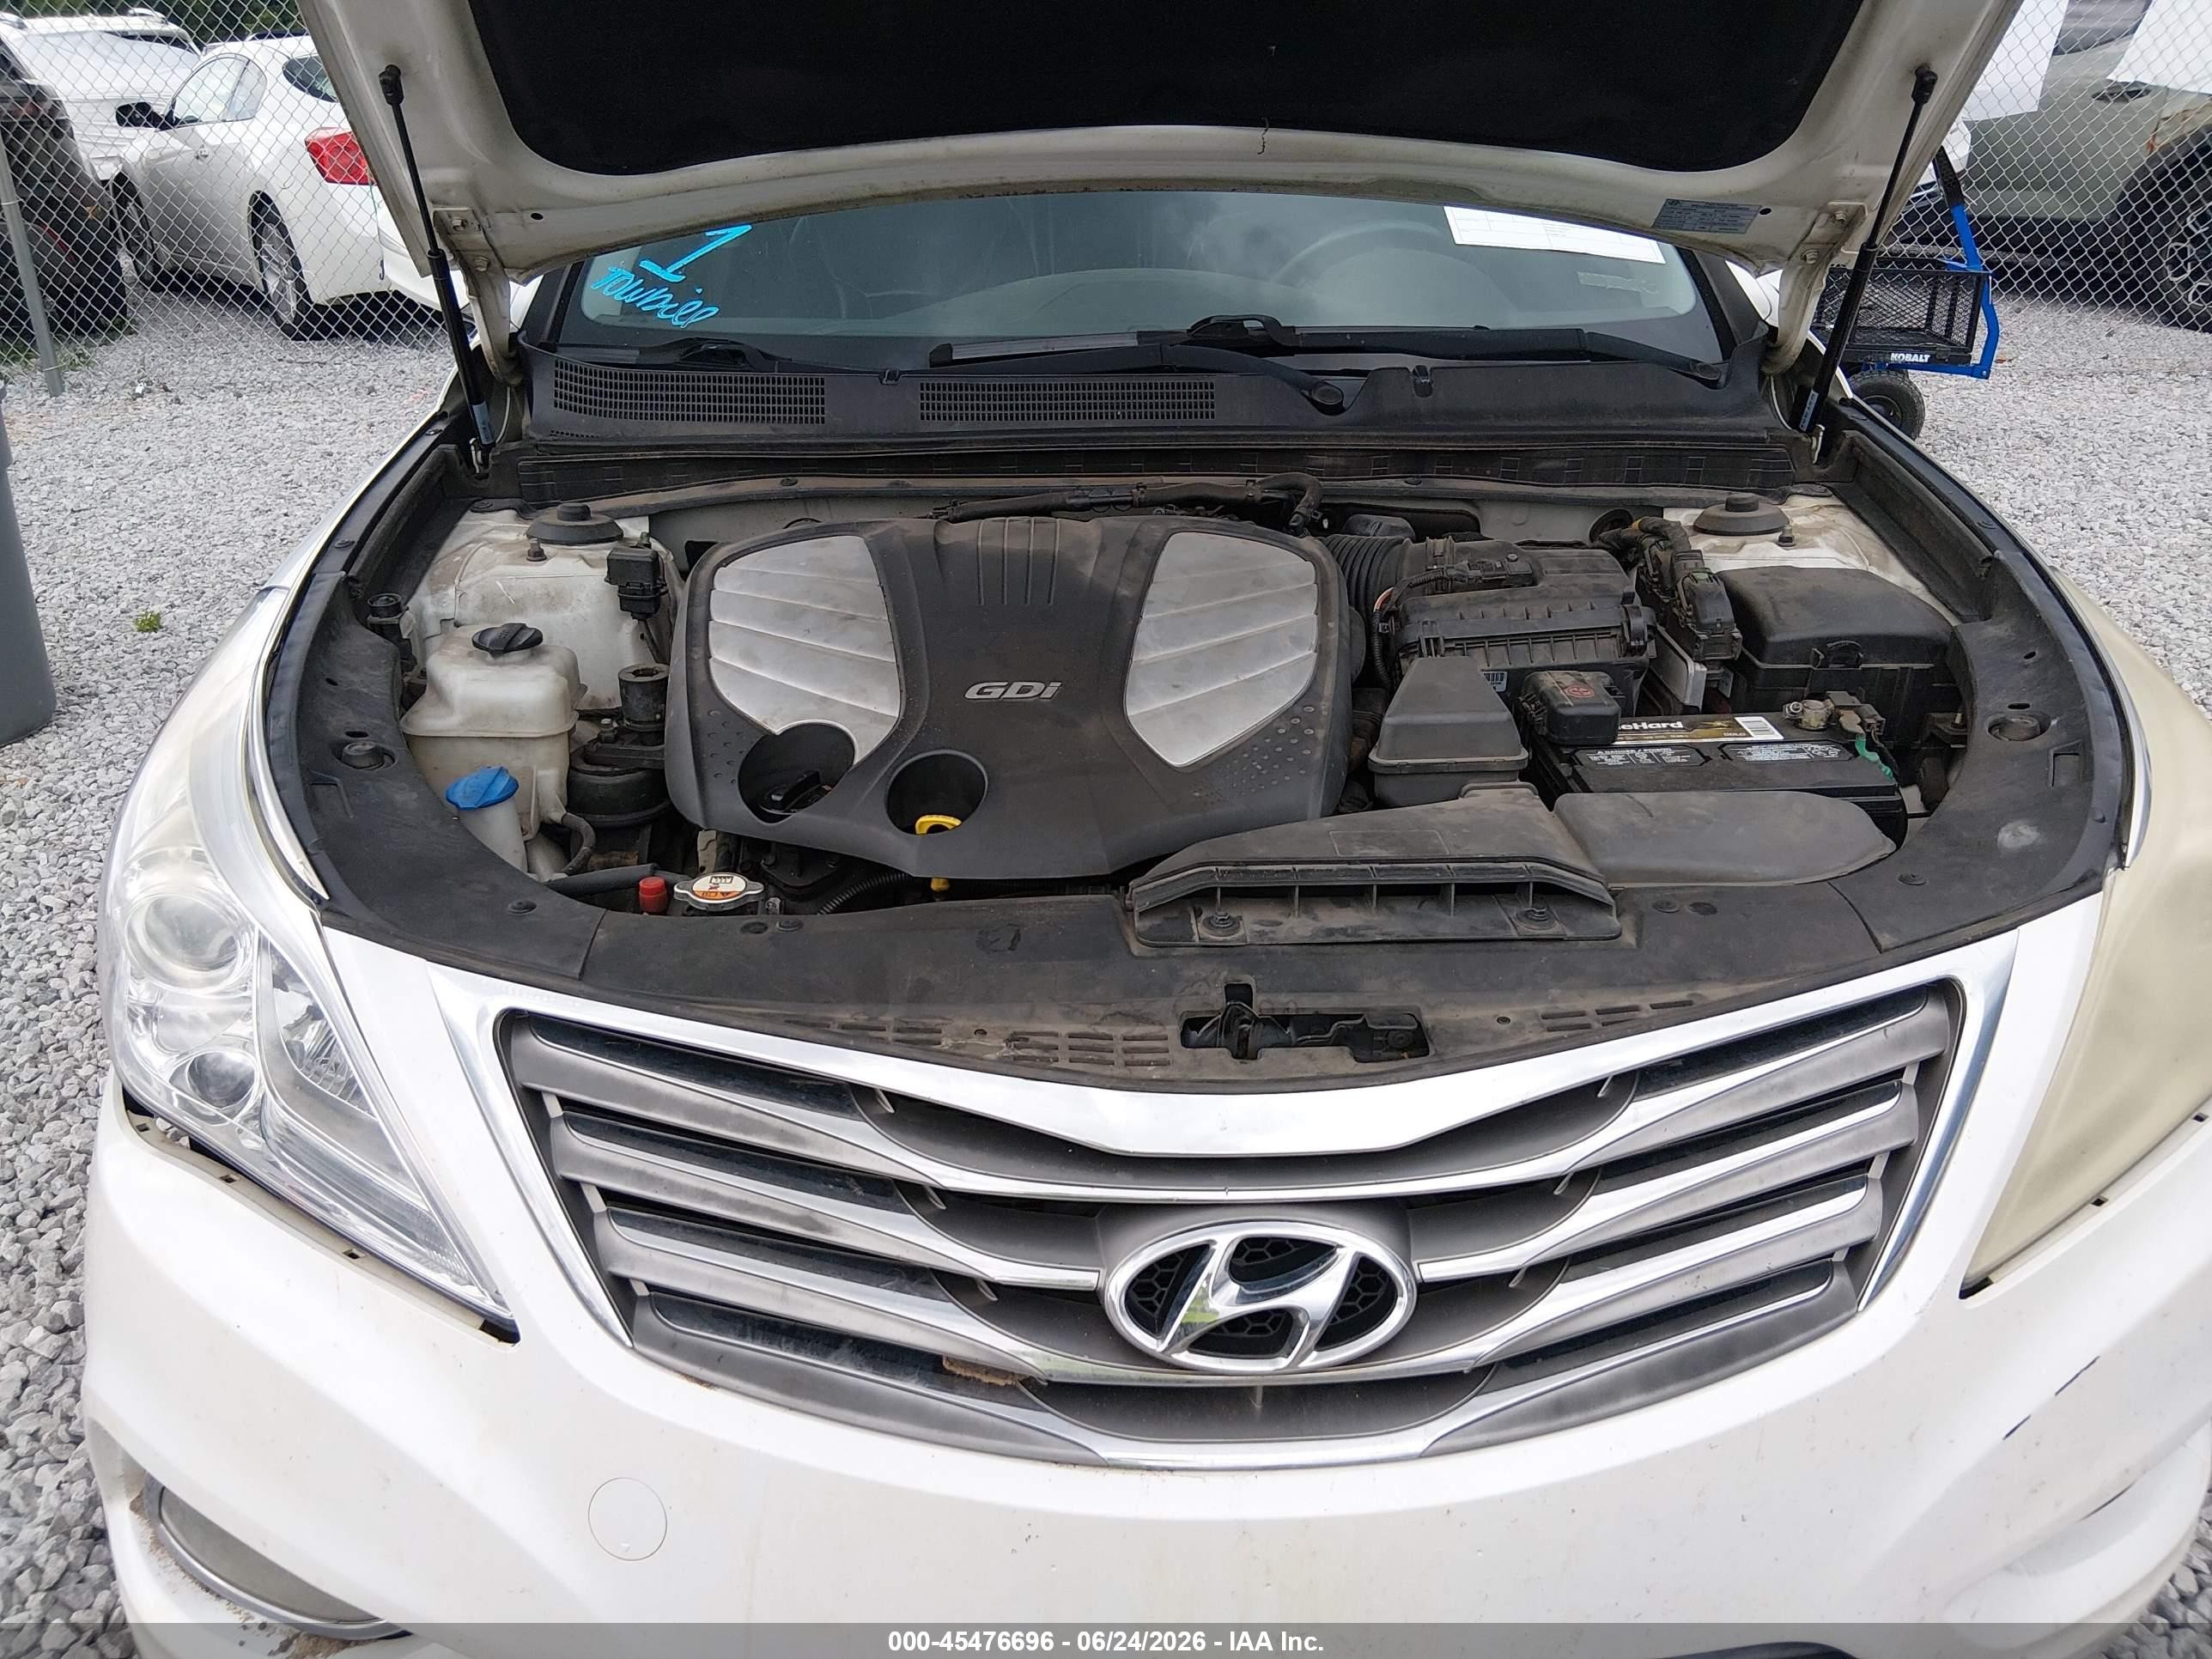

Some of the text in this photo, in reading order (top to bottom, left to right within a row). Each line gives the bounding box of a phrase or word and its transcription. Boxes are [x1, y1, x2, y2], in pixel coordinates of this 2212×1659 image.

[1890, 352, 1930, 362] KOBALT
[964, 681, 1063, 699] GDi
[1618, 720, 1684, 730] eHard
